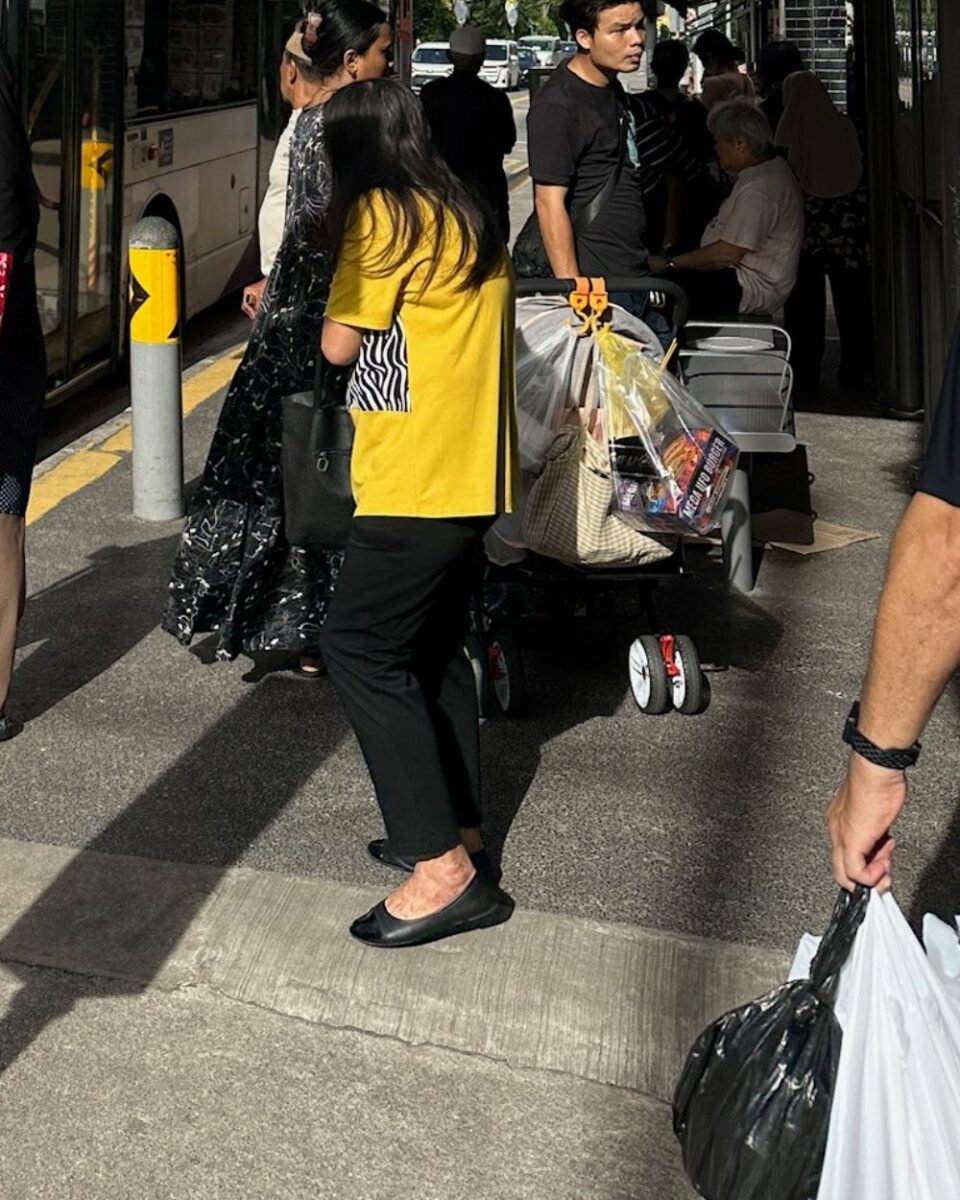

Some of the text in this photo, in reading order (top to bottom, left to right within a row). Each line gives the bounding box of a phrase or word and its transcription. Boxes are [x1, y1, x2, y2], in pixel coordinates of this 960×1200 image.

[703, 437, 726, 476] BURGER
[699, 473, 712, 493] UFO
[682, 488, 702, 519] MEGA
